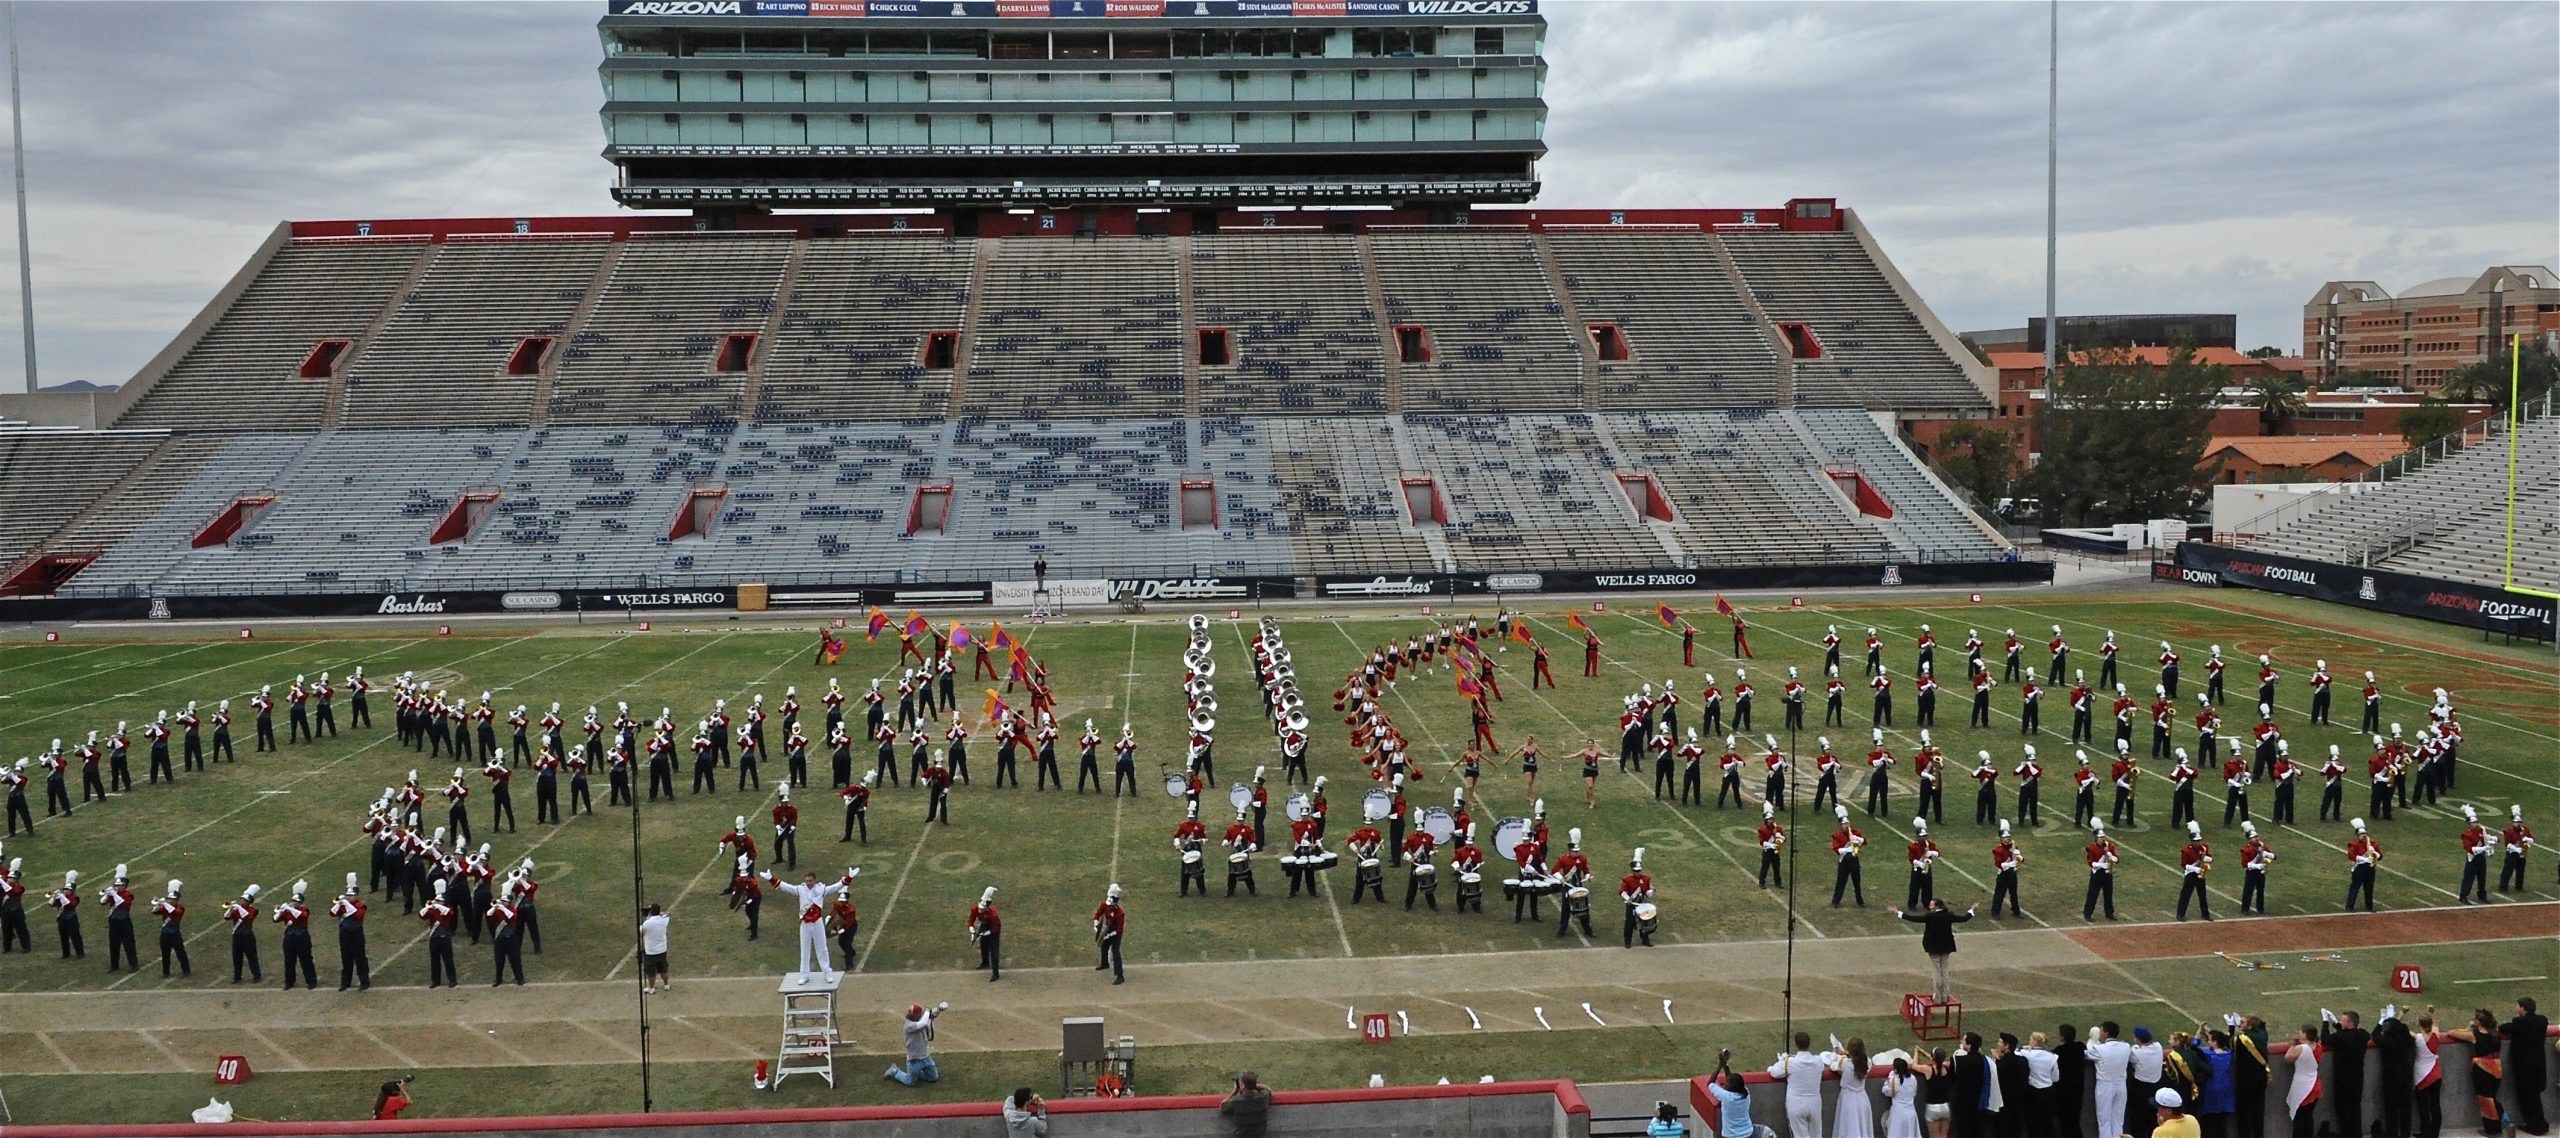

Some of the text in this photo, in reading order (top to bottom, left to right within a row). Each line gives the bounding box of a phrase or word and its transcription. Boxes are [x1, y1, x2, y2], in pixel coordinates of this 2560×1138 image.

[623, 1, 741, 15] ARIZONA
[1408, 1, 1531, 14] WILDCATS
[893, 221, 907, 229] 20
[1042, 219, 1054, 228] 21
[1263, 218, 1275, 226] 22
[1456, 217, 1468, 225] 23
[1611, 216, 1623, 224] 24
[1743, 216, 1755, 224] 25
[359, 228, 369, 236] 17
[516, 225, 528, 233] 18
[696, 223, 706, 231] 19
[1595, 574, 1696, 586] WELLS FARGO
[2156, 565, 2217, 585] BEAR DOWN
[2264, 566, 2317, 586] FOOTBALL
[995, 588, 1031, 599] UNIVERSITY
[1072, 586, 1091, 597] BAND
[1092, 586, 1105, 596] DAY
[378, 595, 446, 614] Bashas'
[617, 593, 725, 605] WELLS FARGO
[2427, 592, 2480, 613] ARIZONA
[2400, 969, 2420, 989] 20
[1367, 1018, 1386, 1039] 40
[217, 1059, 239, 1081] 40
